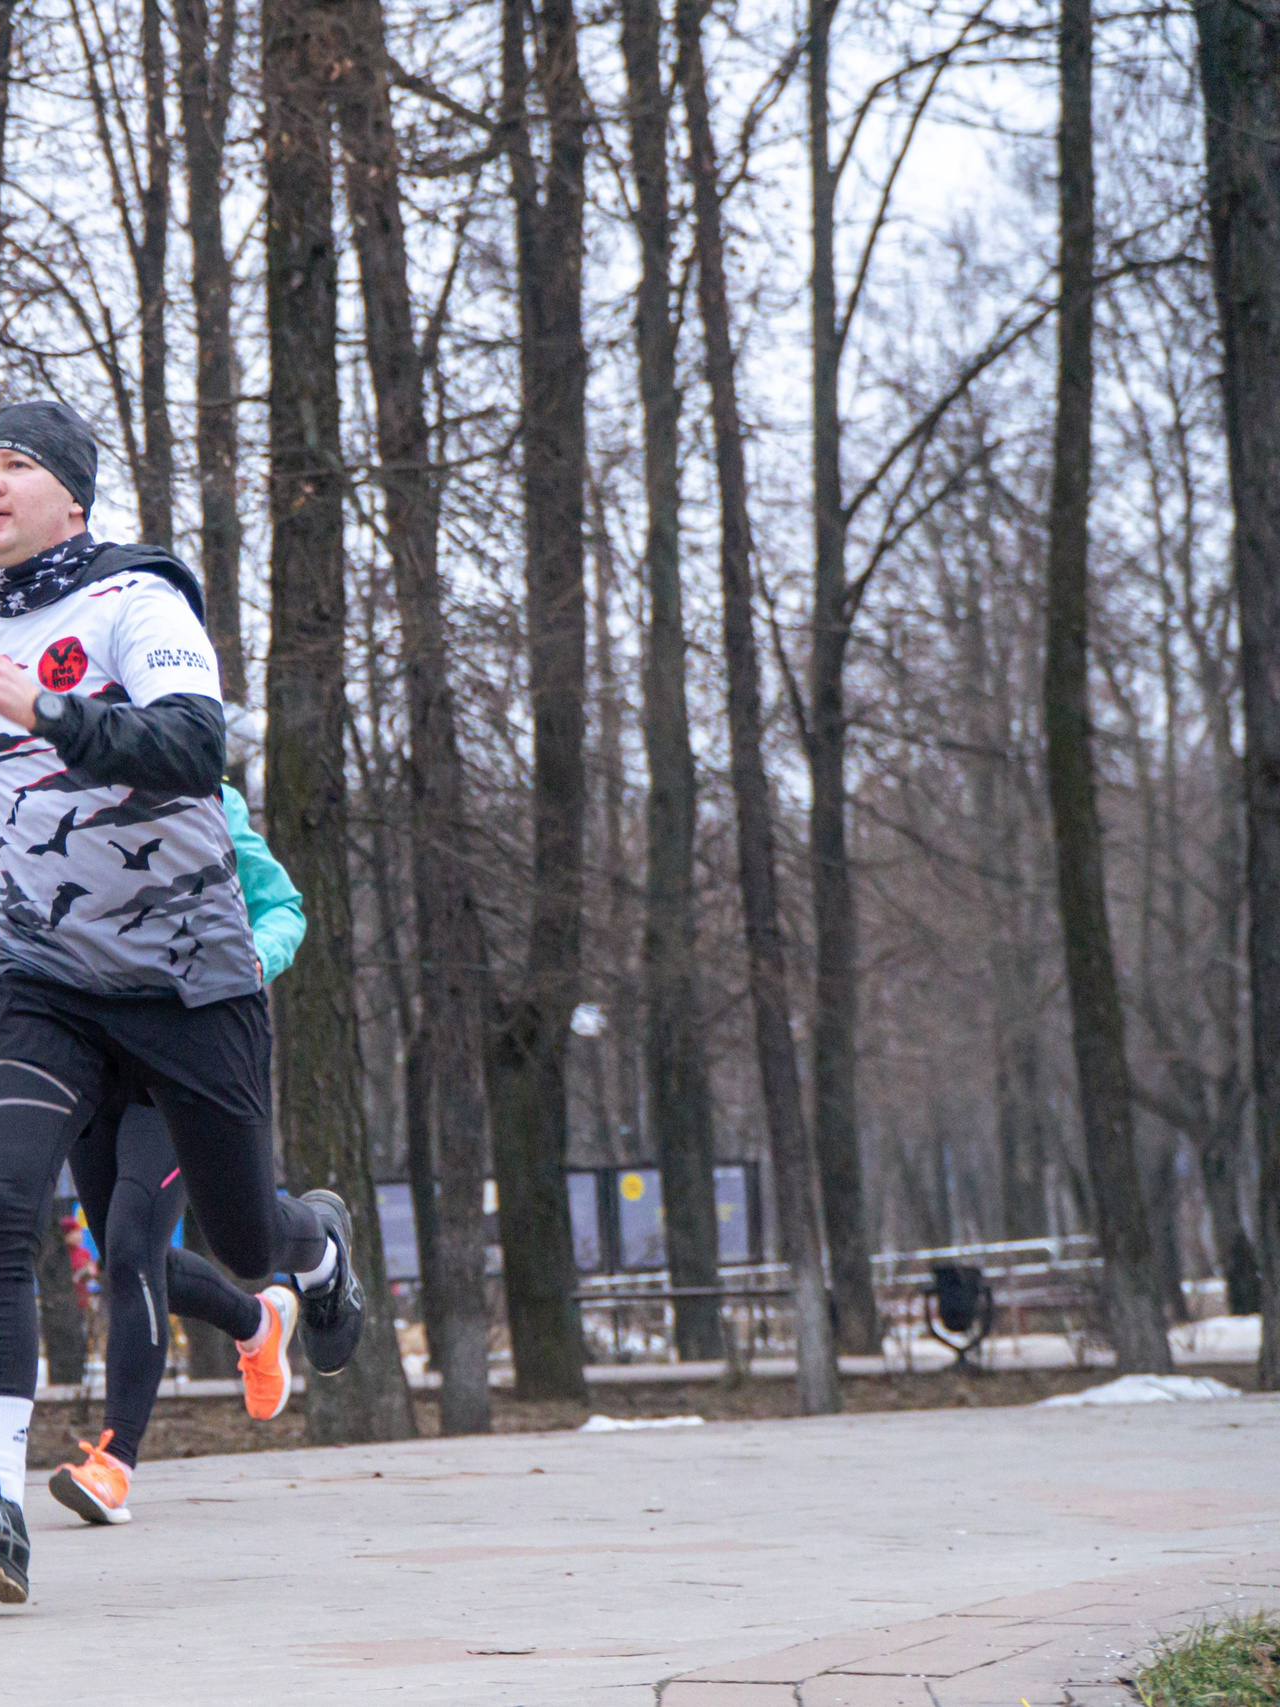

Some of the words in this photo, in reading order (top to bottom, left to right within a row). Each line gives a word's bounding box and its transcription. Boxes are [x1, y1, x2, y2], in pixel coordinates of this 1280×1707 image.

[146, 649, 171, 657] RUN
[149, 661, 180, 669] SWIM
[186, 662, 210, 671] BIKE
[52, 674, 75, 687] RUN
